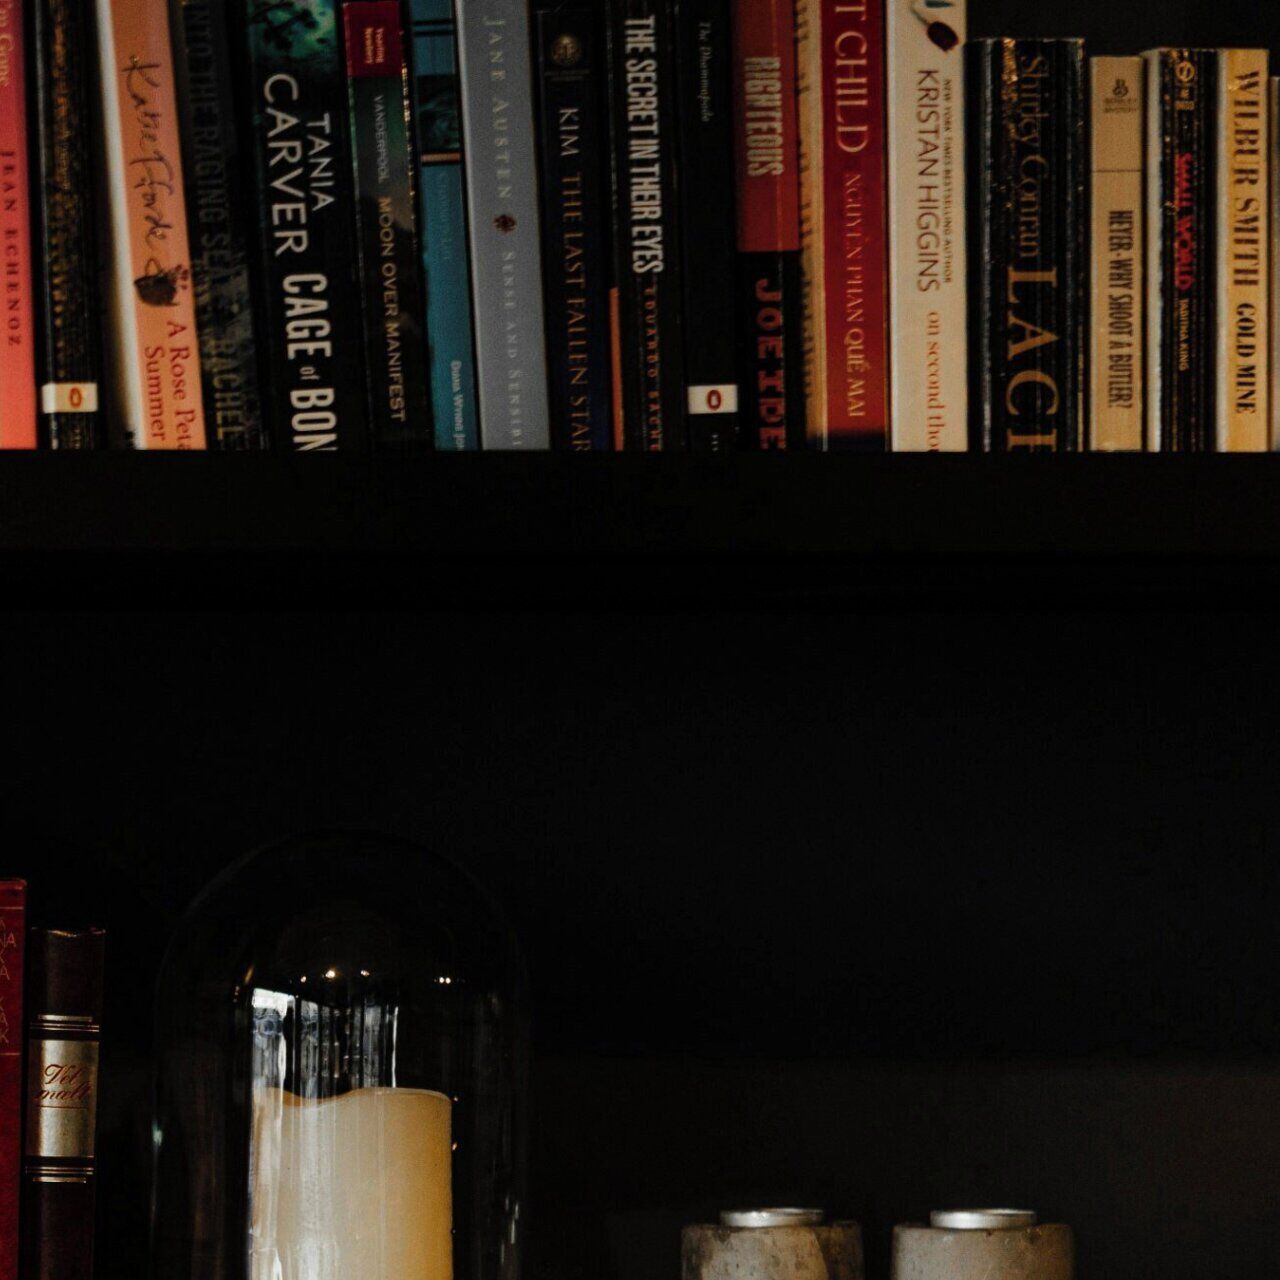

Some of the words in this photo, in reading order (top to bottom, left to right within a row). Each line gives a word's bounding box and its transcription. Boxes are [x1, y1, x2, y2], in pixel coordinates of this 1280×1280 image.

[482, 16, 507, 81] JANE
[624, 16, 656, 54] THE
[190, 65, 220, 118] THE
[627, 59, 659, 133] SECRET
[743, 56, 784, 176] RIGHTEOUS
[833, 31, 869, 153] CHILD
[944, 79, 952, 102] NEW
[944, 106, 952, 133] YORK
[1015, 55, 1051, 147] Shirley
[490, 98, 512, 199] AUSTEN
[558, 107, 580, 157] KIM
[628, 139, 659, 159] IN
[916, 70, 940, 176] KRISTAN
[944, 137, 952, 166] TIMES
[1233, 71, 1261, 186] WILBUR
[194, 125, 229, 224] RAGING
[263, 72, 308, 257] CARVER
[307, 112, 335, 212] TANIA
[630, 163, 662, 218] THEIR
[1175, 151, 1195, 207] SMALL
[377, 196, 396, 256] MOON
[560, 171, 583, 223] THE
[944, 169, 952, 236] BESTSELLING
[1018, 152, 1050, 260] Conran
[562, 231, 585, 290] LAST
[631, 225, 664, 273] EYES
[917, 186, 941, 293] HIGGINS
[944, 240, 952, 284] AUTHOR
[1174, 214, 1195, 291] WORLD
[1233, 197, 1261, 287] SMITH
[4, 229, 21, 347] ECHENOZ
[381, 263, 398, 316] OVER
[501, 250, 516, 310] SENSE
[846, 266, 865, 323] PHAN
[167, 320, 187, 337] A
[281, 272, 333, 359] CAGE
[506, 321, 520, 358] AND
[565, 297, 589, 385] FALLEN
[754, 278, 784, 359] JOE
[926, 311, 943, 335] on
[1109, 294, 1133, 337] SHOOT
[1235, 303, 1256, 357] GOLD
[170, 346, 191, 400] Rose
[300, 366, 319, 381] of
[385, 320, 406, 422] MANIFEST
[926, 340, 945, 410] second
[1109, 341, 1133, 350] A
[1178, 341, 1190, 371] KING
[144, 346, 166, 441] Summer
[208, 338, 245, 441] RACHEL
[756, 368, 787, 451] IDE
[847, 379, 865, 417] MAI
[1109, 354, 1133, 409] BUTLER?
[1236, 363, 1257, 414] MINE
[569, 394, 592, 451] STAR
